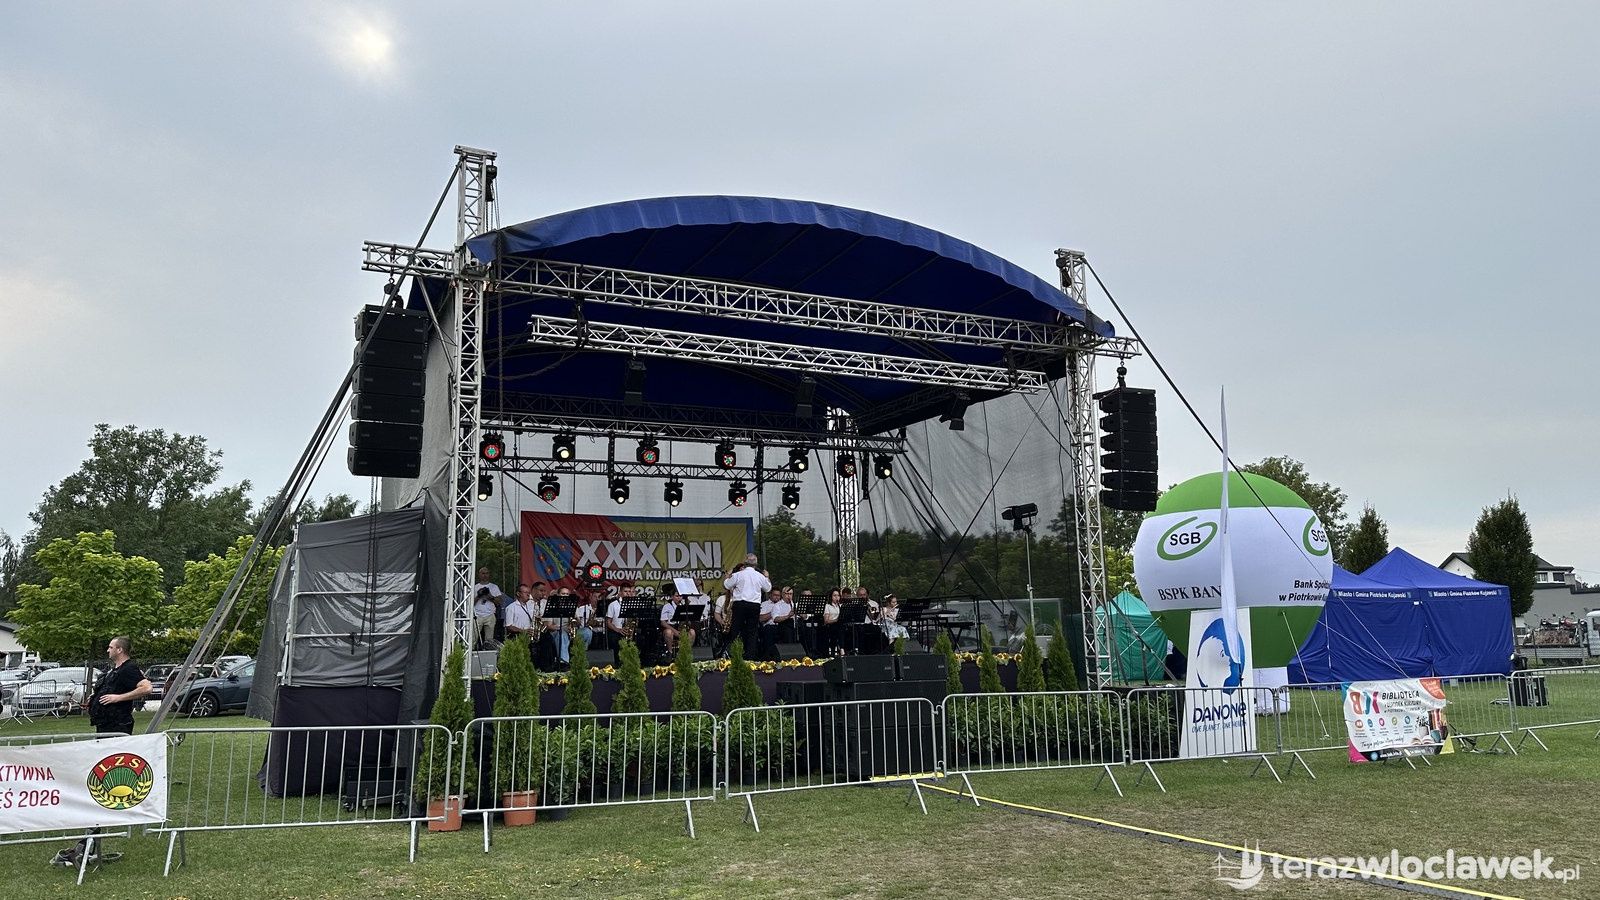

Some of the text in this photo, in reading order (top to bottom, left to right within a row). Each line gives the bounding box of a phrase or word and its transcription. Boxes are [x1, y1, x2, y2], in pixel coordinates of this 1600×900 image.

[612, 531, 687, 540] ZAPRASZAMY NA
[1169, 532, 1202, 546] SGB
[576, 539, 722, 569] XXIX DNI
[1294, 579, 1313, 589] Bank
[607, 586, 655, 599] 226
[1158, 585, 1222, 602] BSPK BAN
[1279, 594, 1287, 602] w
[1288, 592, 1323, 602] Piotrkowie
[1337, 590, 1353, 598] Miasto
[1382, 690, 1420, 700] BIBLIOTEKA
[99, 755, 141, 772] LZS
[18, 789, 60, 808] 2026
